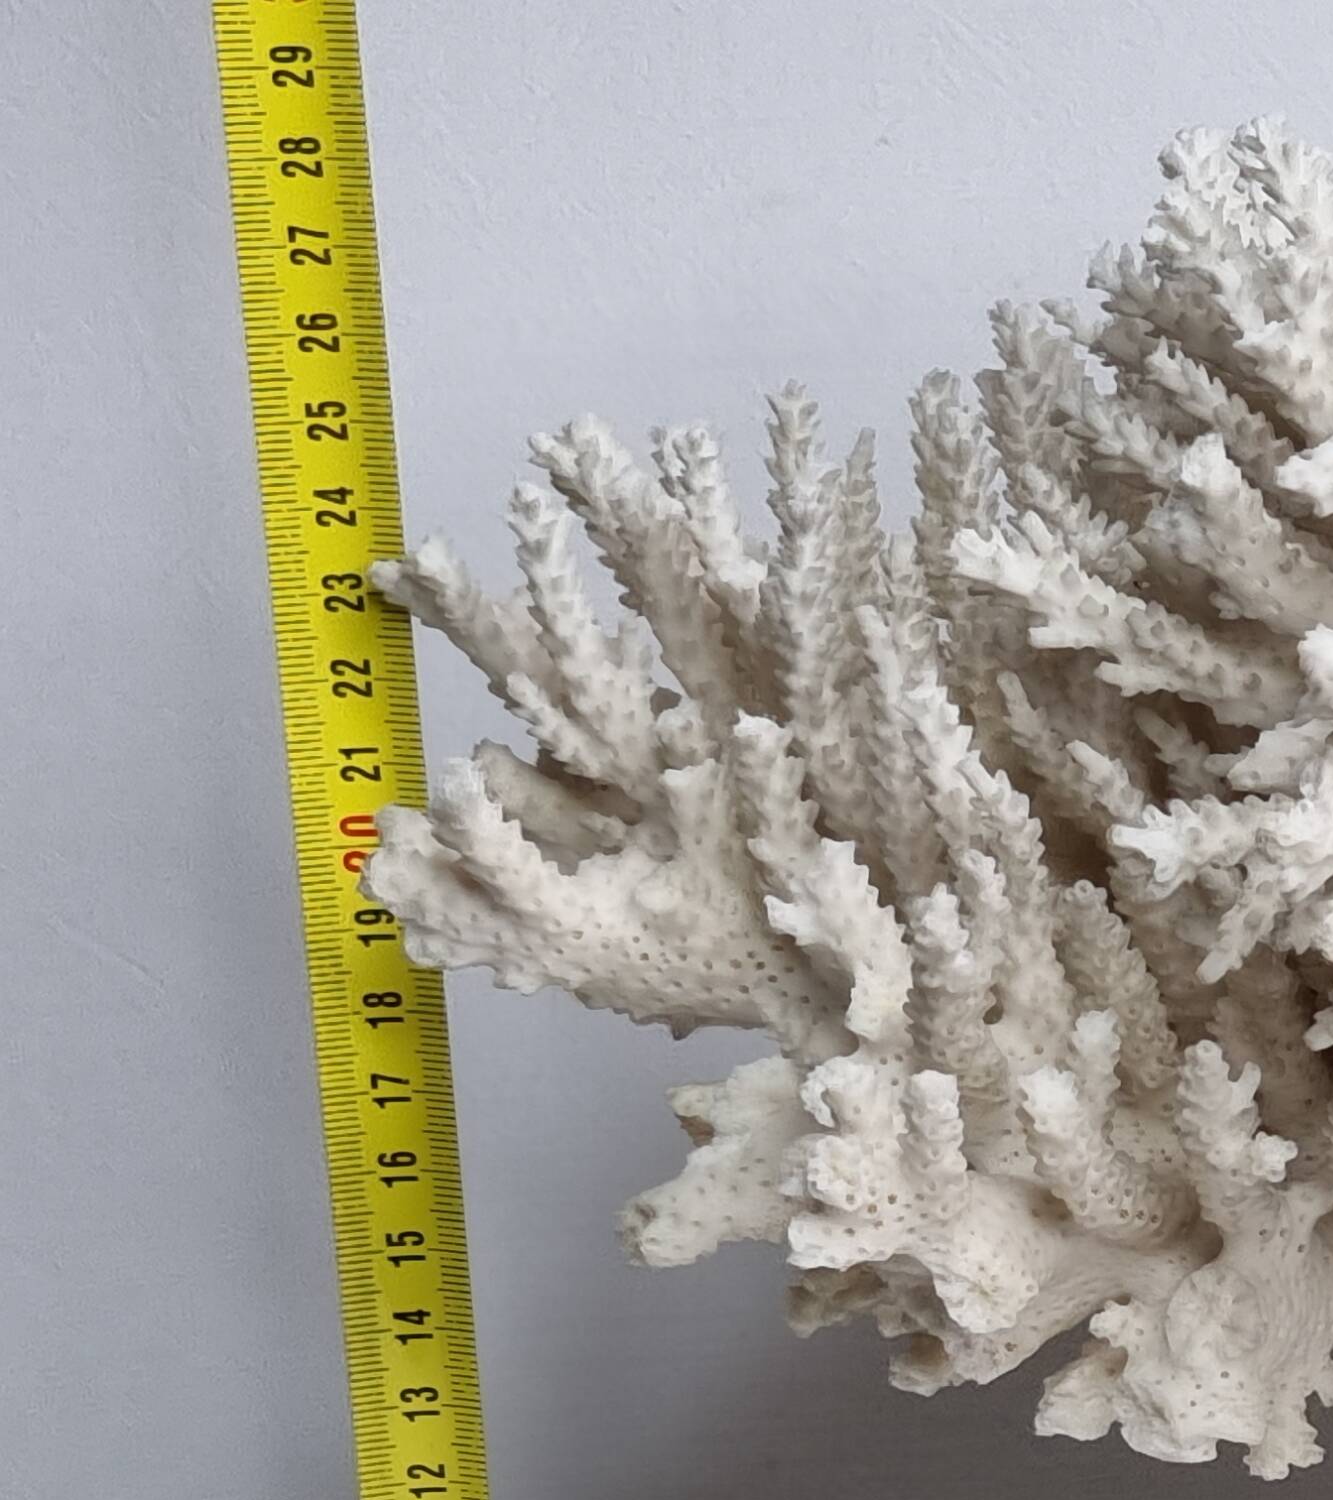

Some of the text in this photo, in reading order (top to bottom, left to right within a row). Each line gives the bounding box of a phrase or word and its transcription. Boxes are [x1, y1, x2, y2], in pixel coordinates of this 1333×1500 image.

[269, 45, 315, 88] 29
[278, 136, 324, 178] 28
[287, 225, 332, 266] 27
[295, 312, 341, 353] 26
[304, 400, 349, 442] 25
[313, 486, 358, 527] 24
[321, 571, 366, 614] 23
[329, 658, 374, 698] 22
[338, 747, 382, 782] 21
[353, 908, 398, 948] 19
[362, 991, 405, 1030] 18
[370, 1073, 413, 1109] 17
[377, 1151, 420, 1189] 16
[385, 1230, 427, 1268] 15
[392, 1308, 434, 1346] 14
[399, 1386, 441, 1423] 13
[406, 1463, 448, 1499] 12
